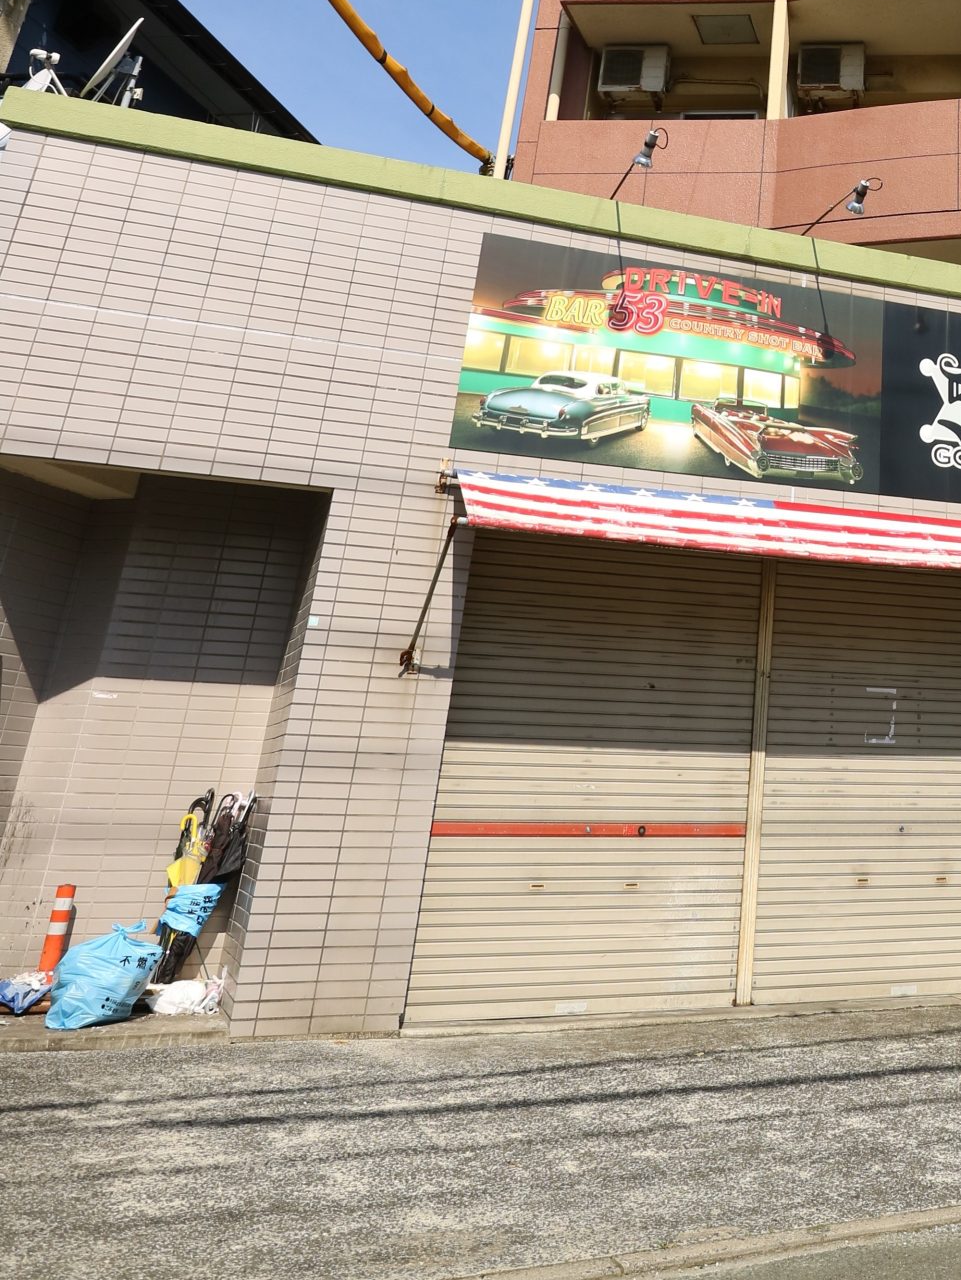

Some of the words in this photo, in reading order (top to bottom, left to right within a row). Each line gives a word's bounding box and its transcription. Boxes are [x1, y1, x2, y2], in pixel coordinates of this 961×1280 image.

[545, 294, 606, 327] BAR
[608, 289, 667, 335] 53
[623, 267, 782, 319] DRIVE-IN
[668, 318, 744, 341] COUNTRY
[747, 329, 789, 349] SHOT
[791, 340, 823, 358] BAR
